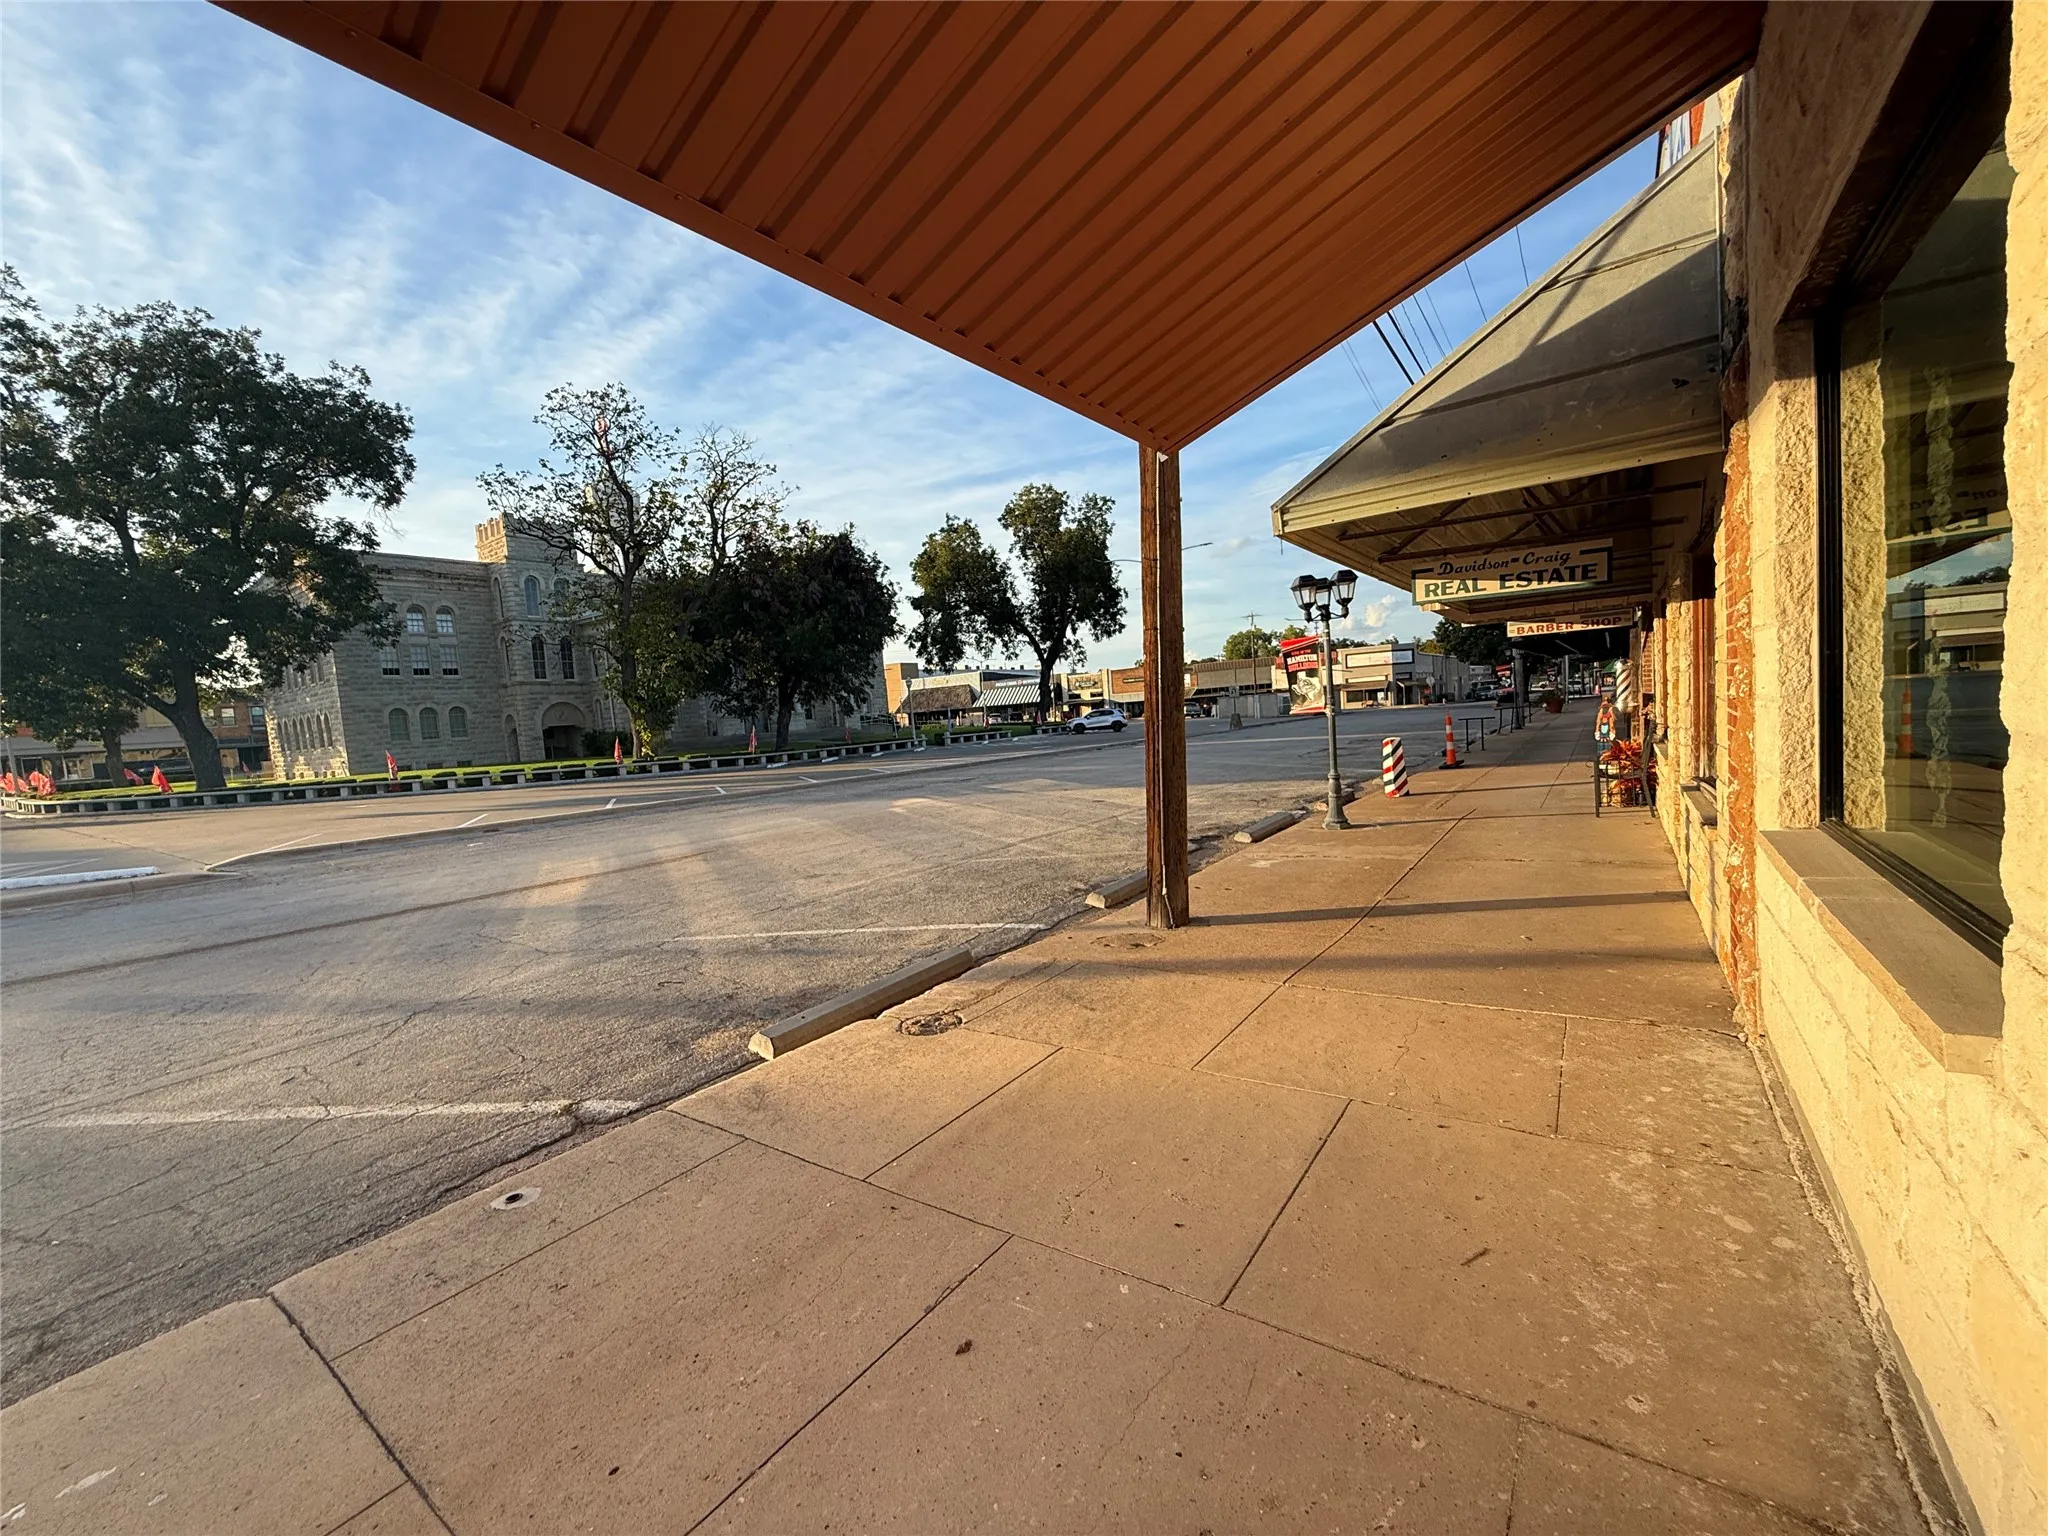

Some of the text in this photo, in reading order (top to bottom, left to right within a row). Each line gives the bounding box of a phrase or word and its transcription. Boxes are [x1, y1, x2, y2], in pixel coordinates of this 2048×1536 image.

[1424, 562, 1598, 599] REAL ESTATE
[1516, 616, 1624, 635] BARBER SHOP
